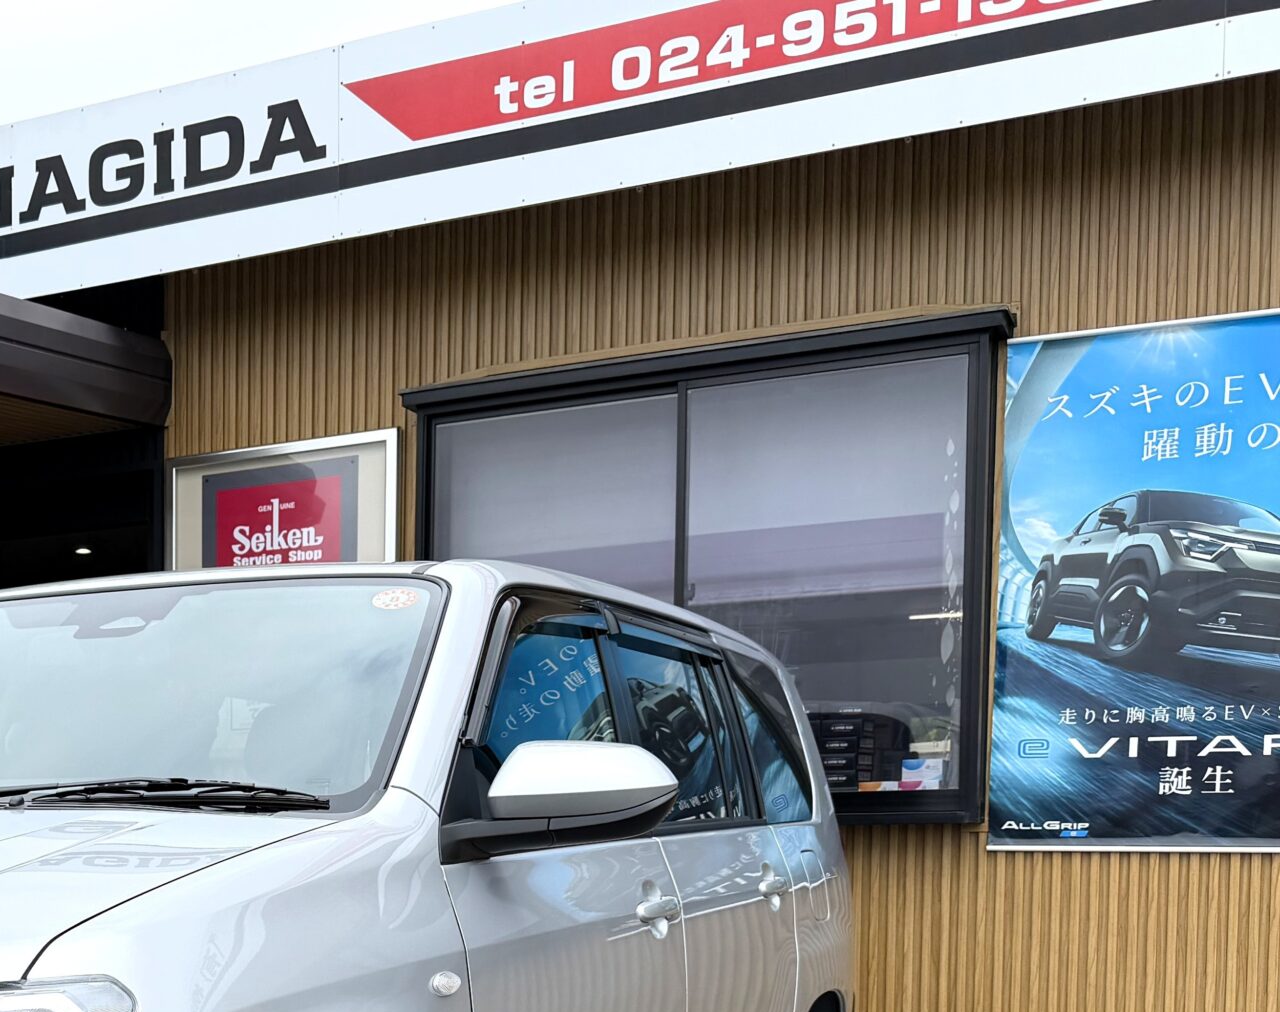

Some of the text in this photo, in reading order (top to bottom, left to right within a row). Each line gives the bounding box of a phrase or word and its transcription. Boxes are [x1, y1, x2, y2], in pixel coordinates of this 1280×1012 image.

[494, 0, 1073, 114] tel 024-951-
[1041, 372, 1280, 421] スズキのEV
[1141, 421, 1280, 462] 躍動の
[231, 498, 324, 555] Seiken
[232, 549, 322, 567] Service Shop
[1058, 704, 1280, 726] 走りに胸高鳴るEV×
[1158, 765, 1235, 796] 誕生
[1001, 820, 1090, 830] ALLGRIP
